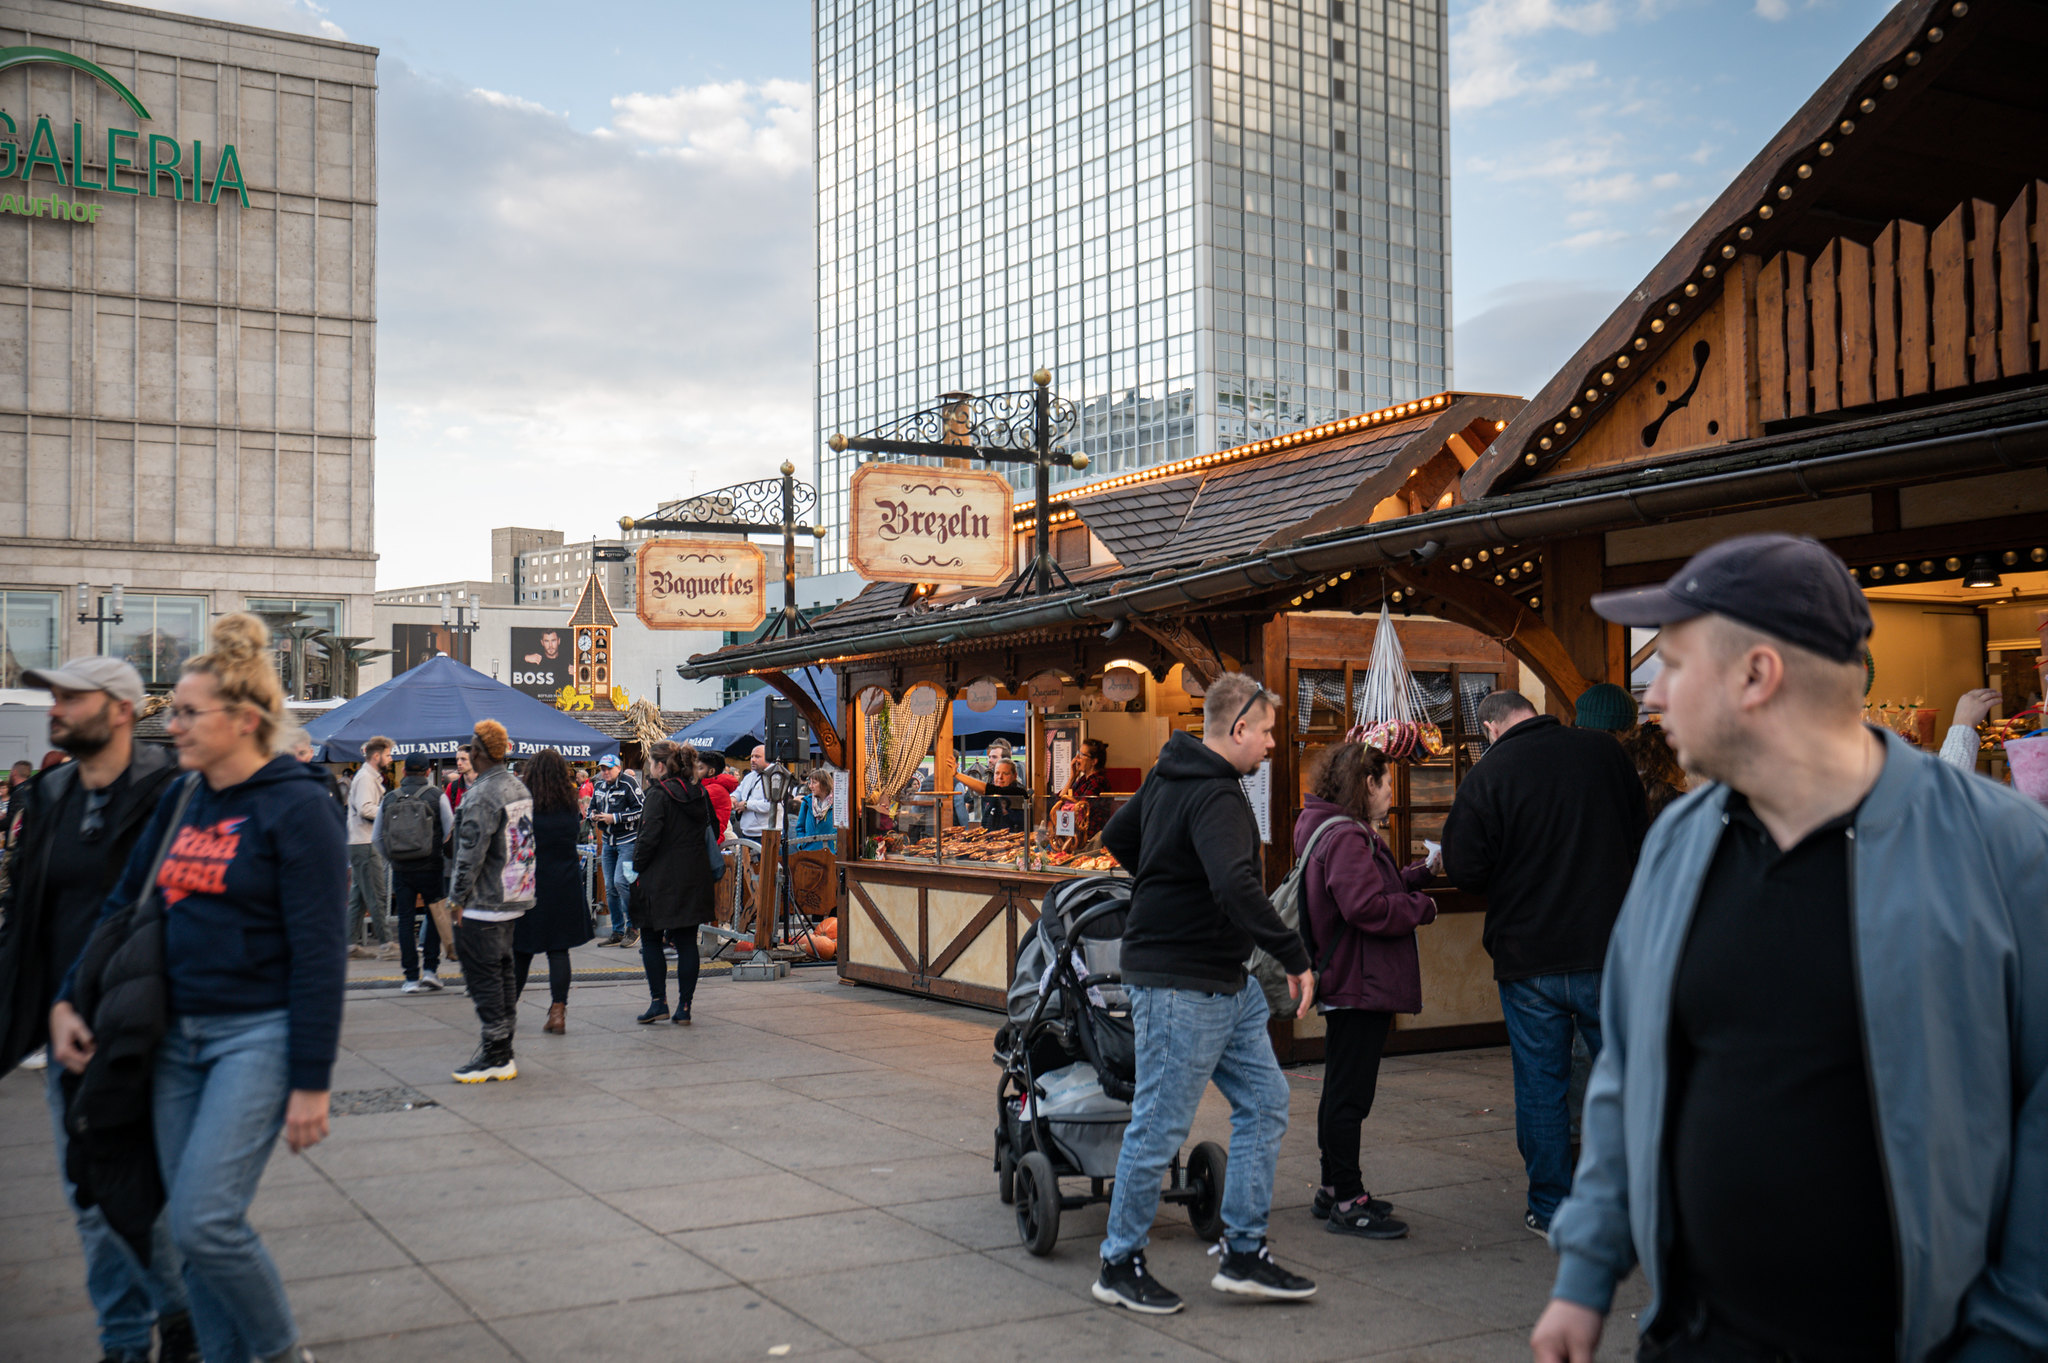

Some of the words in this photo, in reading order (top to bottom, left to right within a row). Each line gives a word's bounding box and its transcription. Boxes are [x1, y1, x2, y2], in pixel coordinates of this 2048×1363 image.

[875, 498, 990, 545] Brezeln
[648, 569, 753, 599] Baguettes
[512, 671, 555, 685] BOSS
